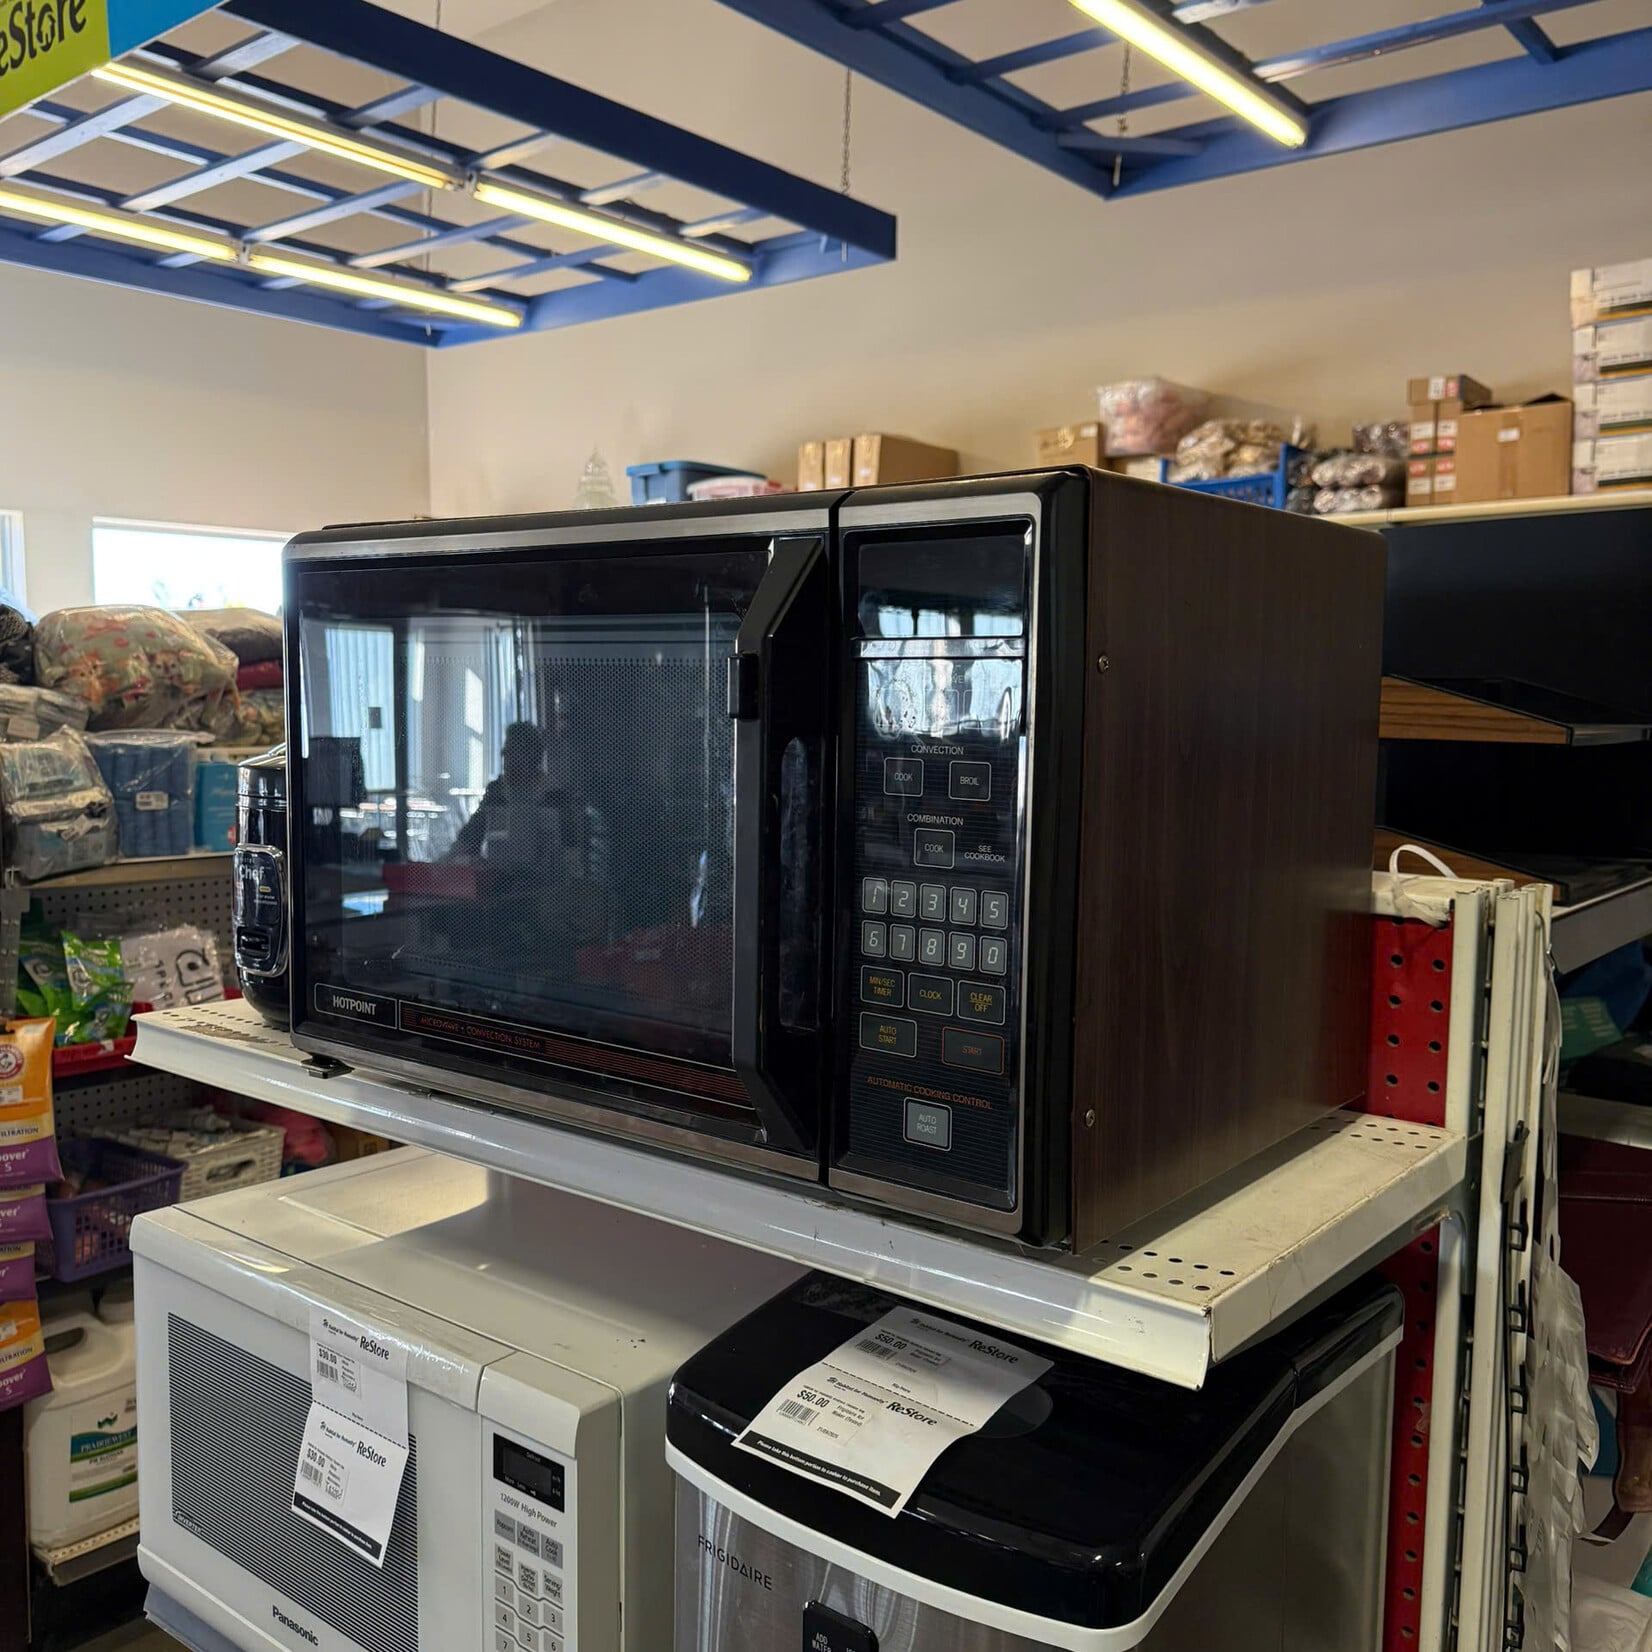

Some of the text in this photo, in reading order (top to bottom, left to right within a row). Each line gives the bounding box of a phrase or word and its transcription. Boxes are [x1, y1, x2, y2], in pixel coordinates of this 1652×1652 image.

[910, 745, 964, 755] CONVECTION
[894, 772, 913, 782] COOK
[959, 776, 979, 786] BROIL
[907, 813, 964, 825] COMBINATION
[924, 843, 944, 853] COOK
[978, 845, 992, 853] SEE
[964, 851, 1005, 863] COOKBOOK
[239, 864, 265, 881] Chef
[898, 890, 909, 907] 2
[928, 894, 938, 911] 3
[958, 898, 968, 915] 4
[989, 901, 999, 919] 5
[869, 930, 999, 965] 6 7 8 9 0
[873, 986, 892, 996] TIMER
[919, 990, 942, 1000] CLOCK
[970, 992, 993, 1003] CLEAR
[332, 995, 377, 1016] HOTPOINT
[974, 1003, 988, 1013] OFF
[879, 1025, 897, 1035] AUTO
[466, 1025, 512, 1043] CONVECTION
[513, 1035, 541, 1049] SYSTEM
[878, 1034, 896, 1044] START
[962, 1044, 982, 1055] START
[867, 1076, 993, 1110] AUTOMATIC COOKING CONTROL
[918, 1113, 937, 1124] AUTO
[916, 1122, 937, 1135] ROAST
[0, 1150, 26, 1162] over
[874, 1332, 908, 1350] $50.00
[360, 1335, 390, 1360] ReStore
[968, 1339, 1019, 1364] ReStore
[797, 1389, 830, 1408] $50.00
[886, 1401, 938, 1426] ReStore
[356, 1440, 387, 1467] ReStore
[500, 1492, 558, 1528] 1200W High Power
[698, 1534, 773, 1591] FRIGIDAIRE
[526, 1604, 532, 1614] 2
[502, 1614, 507, 1623] 4
[551, 1613, 556, 1623] 3
[272, 1604, 319, 1647] Panasonic
[526, 1632, 532, 1642] 5
[815, 1632, 828, 1645] ADD
[551, 1641, 557, 1652] 6
